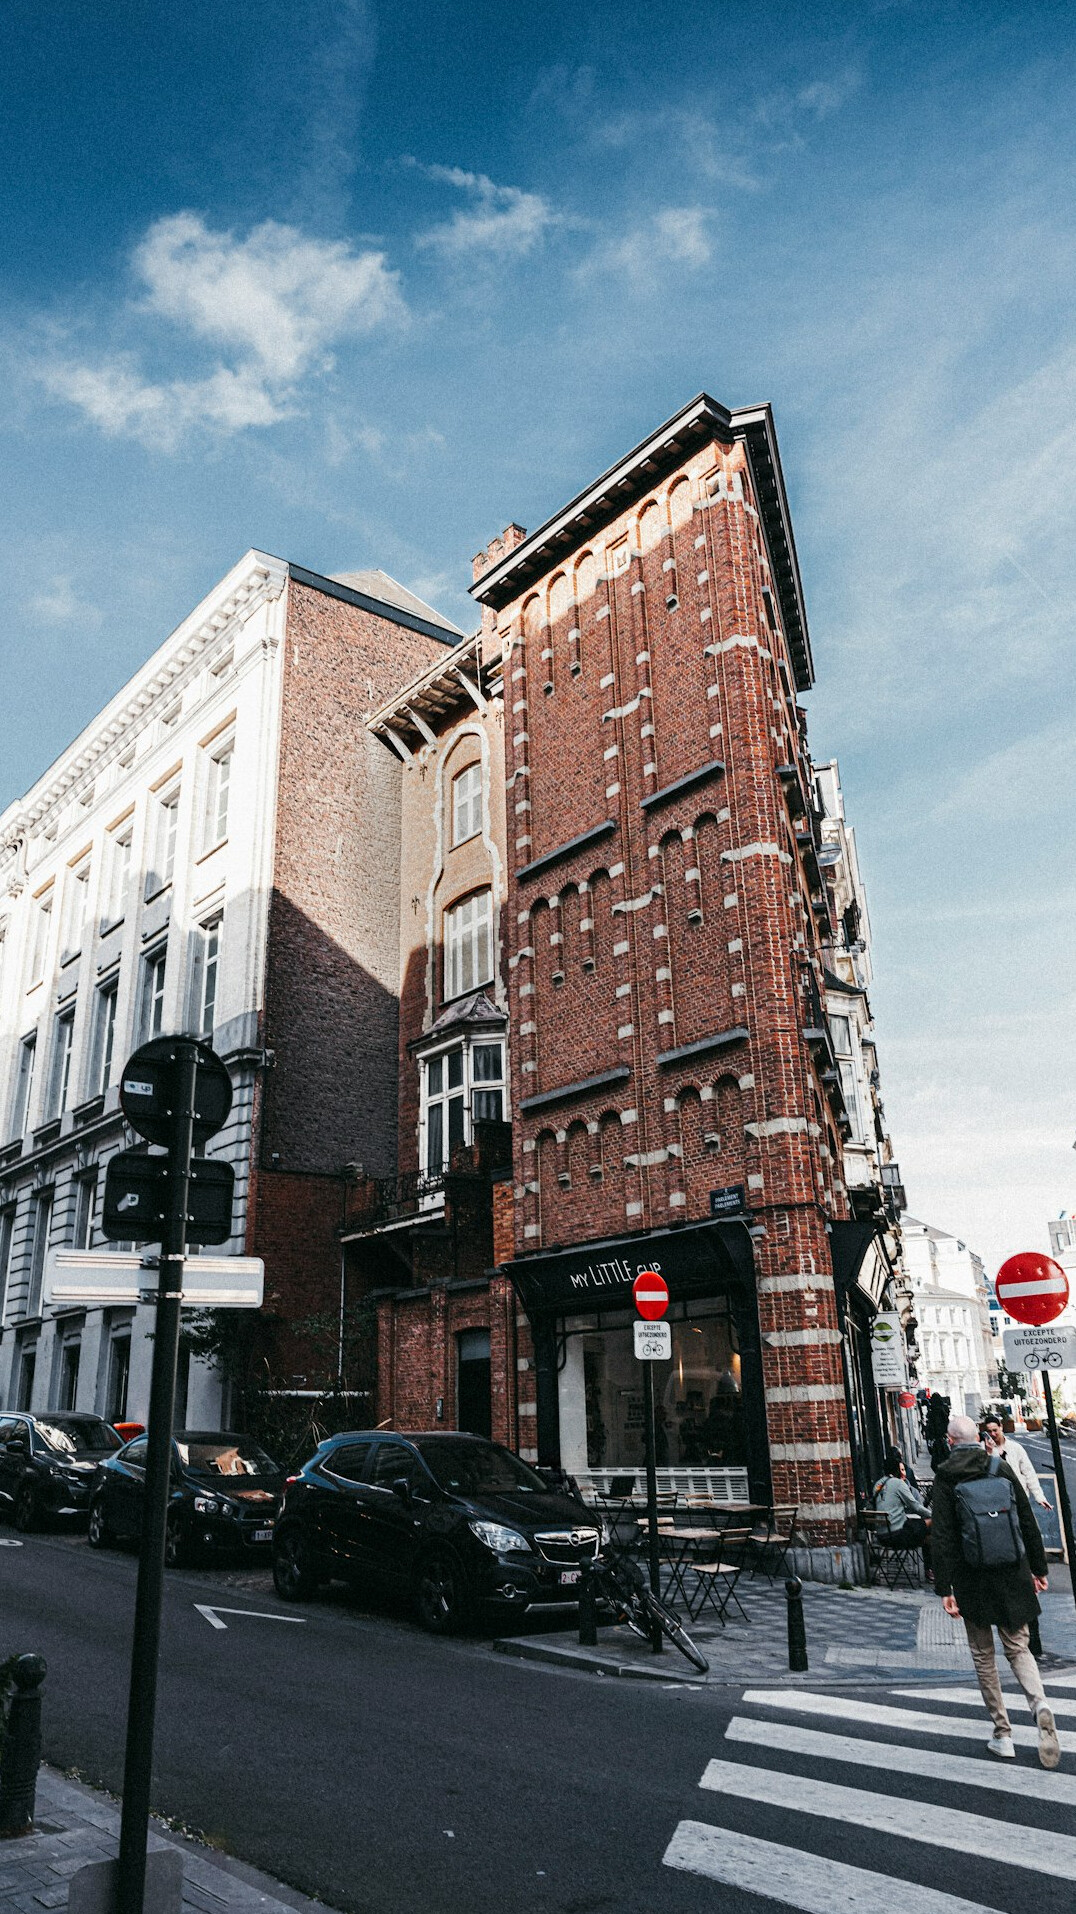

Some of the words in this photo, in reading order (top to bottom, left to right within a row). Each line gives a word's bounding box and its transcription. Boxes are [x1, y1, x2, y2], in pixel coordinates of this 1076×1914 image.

[714, 1193, 739, 1203] PARLEMENT
[569, 1272, 589, 1289] MY
[1023, 1328, 1055, 1337] EXCEPTE
[1014, 1337, 1067, 1346] UITGEZONDERD
